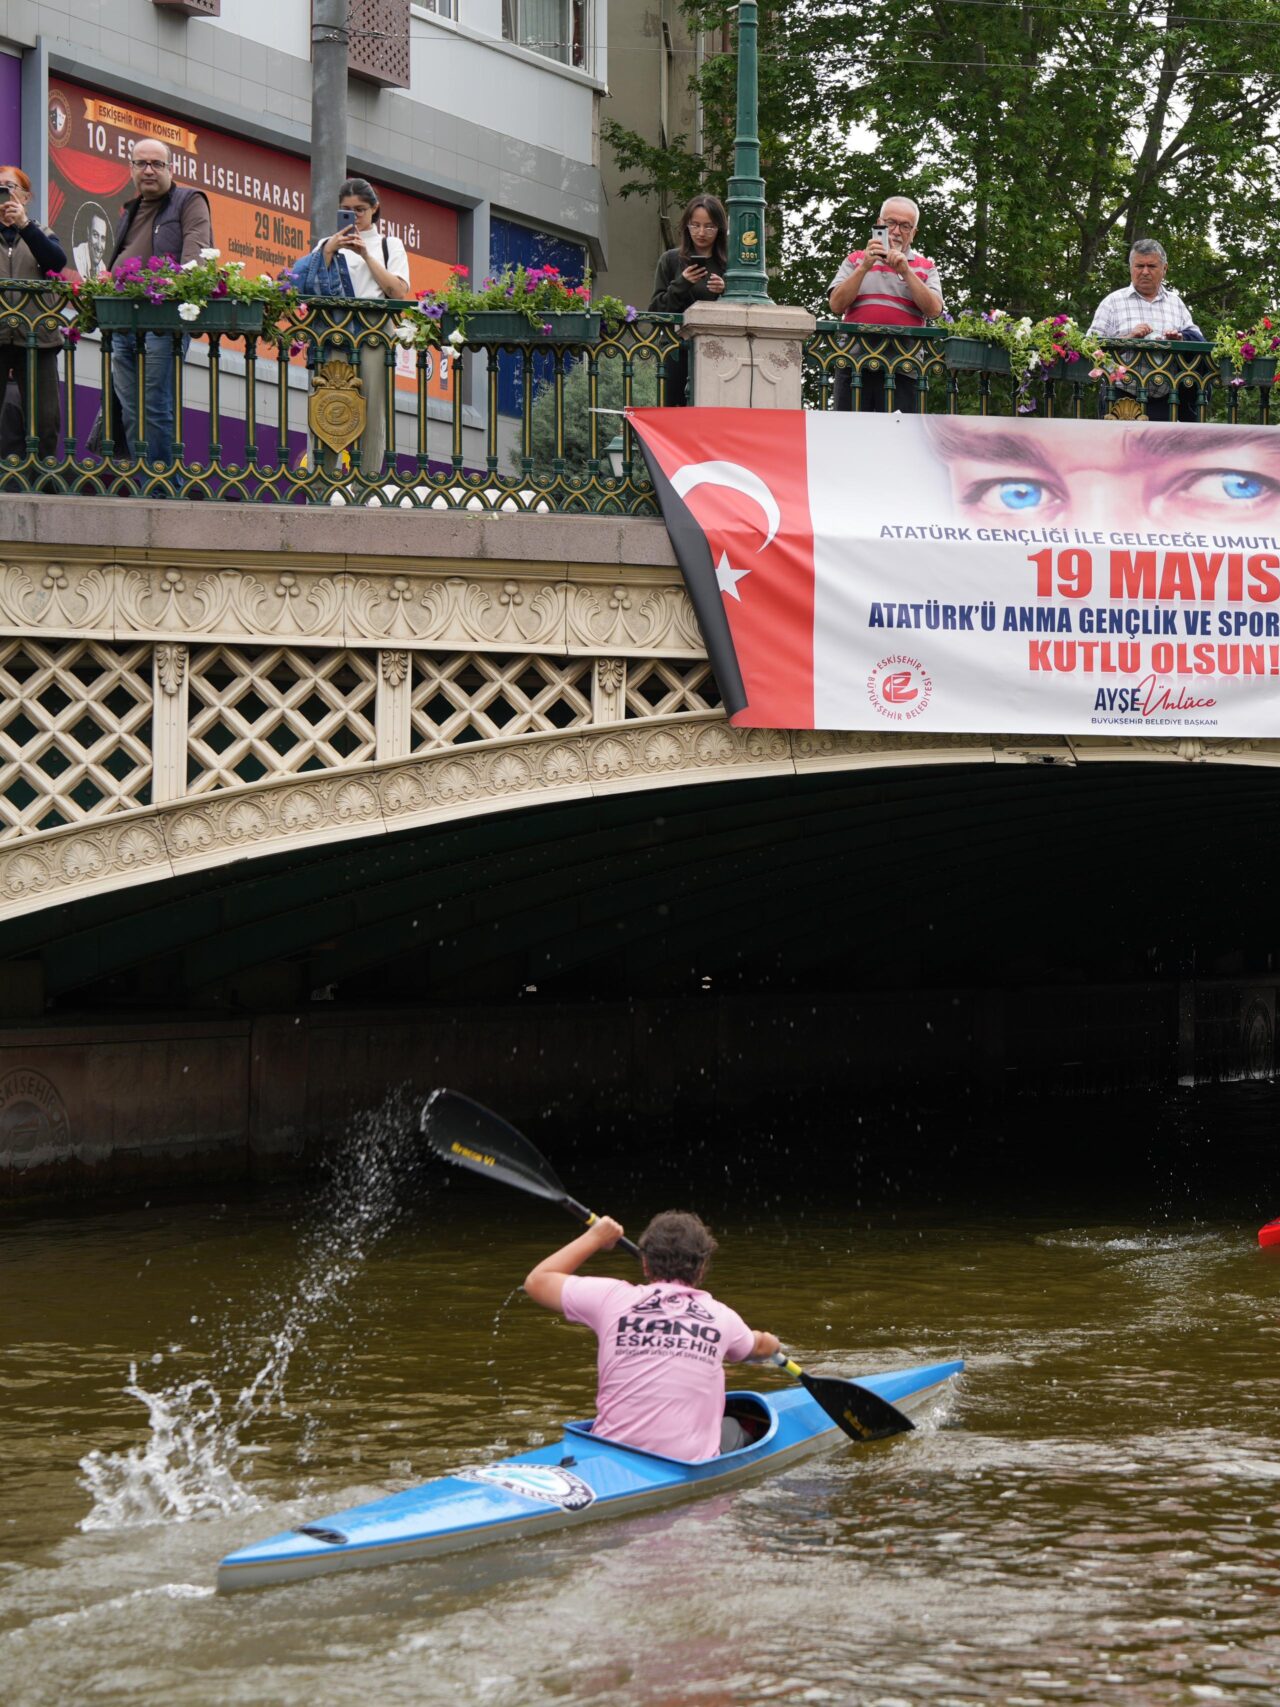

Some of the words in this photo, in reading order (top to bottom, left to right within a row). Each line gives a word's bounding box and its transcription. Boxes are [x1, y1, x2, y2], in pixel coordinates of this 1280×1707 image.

[98, 105, 133, 124] ESKİŞEHİR
[133, 116, 152, 131] KENT
[152, 123, 182, 141] KONSEYİ
[86, 122, 113, 154] 10.
[118, 136, 198, 181] ESHİR
[203, 163, 306, 214] LİSELERARASI
[228, 237, 254, 258] Eskişehir
[254, 211, 271, 240] 29
[273, 216, 304, 251] Nisan
[880, 524, 972, 541] ATATÜRK
[977, 527, 1069, 546] GENÇLİĞİ
[1075, 528, 1105, 545] İLE
[1110, 531, 1209, 549] GELECEĞE
[1027, 548, 1093, 599] 19
[1109, 549, 1280, 603] MAYIS
[1002, 606, 1072, 633] ANMA
[1079, 604, 1178, 640] GENÇLİK
[1184, 610, 1211, 636] VE
[1218, 610, 1280, 637] SPOR
[876, 654, 922, 670] ESKİŞEHİR
[1029, 640, 1141, 674] KUTLU
[1151, 642, 1280, 676] OLSUN!
[1094, 687, 1141, 714] AYŞE
[1136, 674, 1217, 717] Ünlüce
[615, 1334, 718, 1358] ESKİŞEHİR
[617, 1315, 722, 1344] KANO
